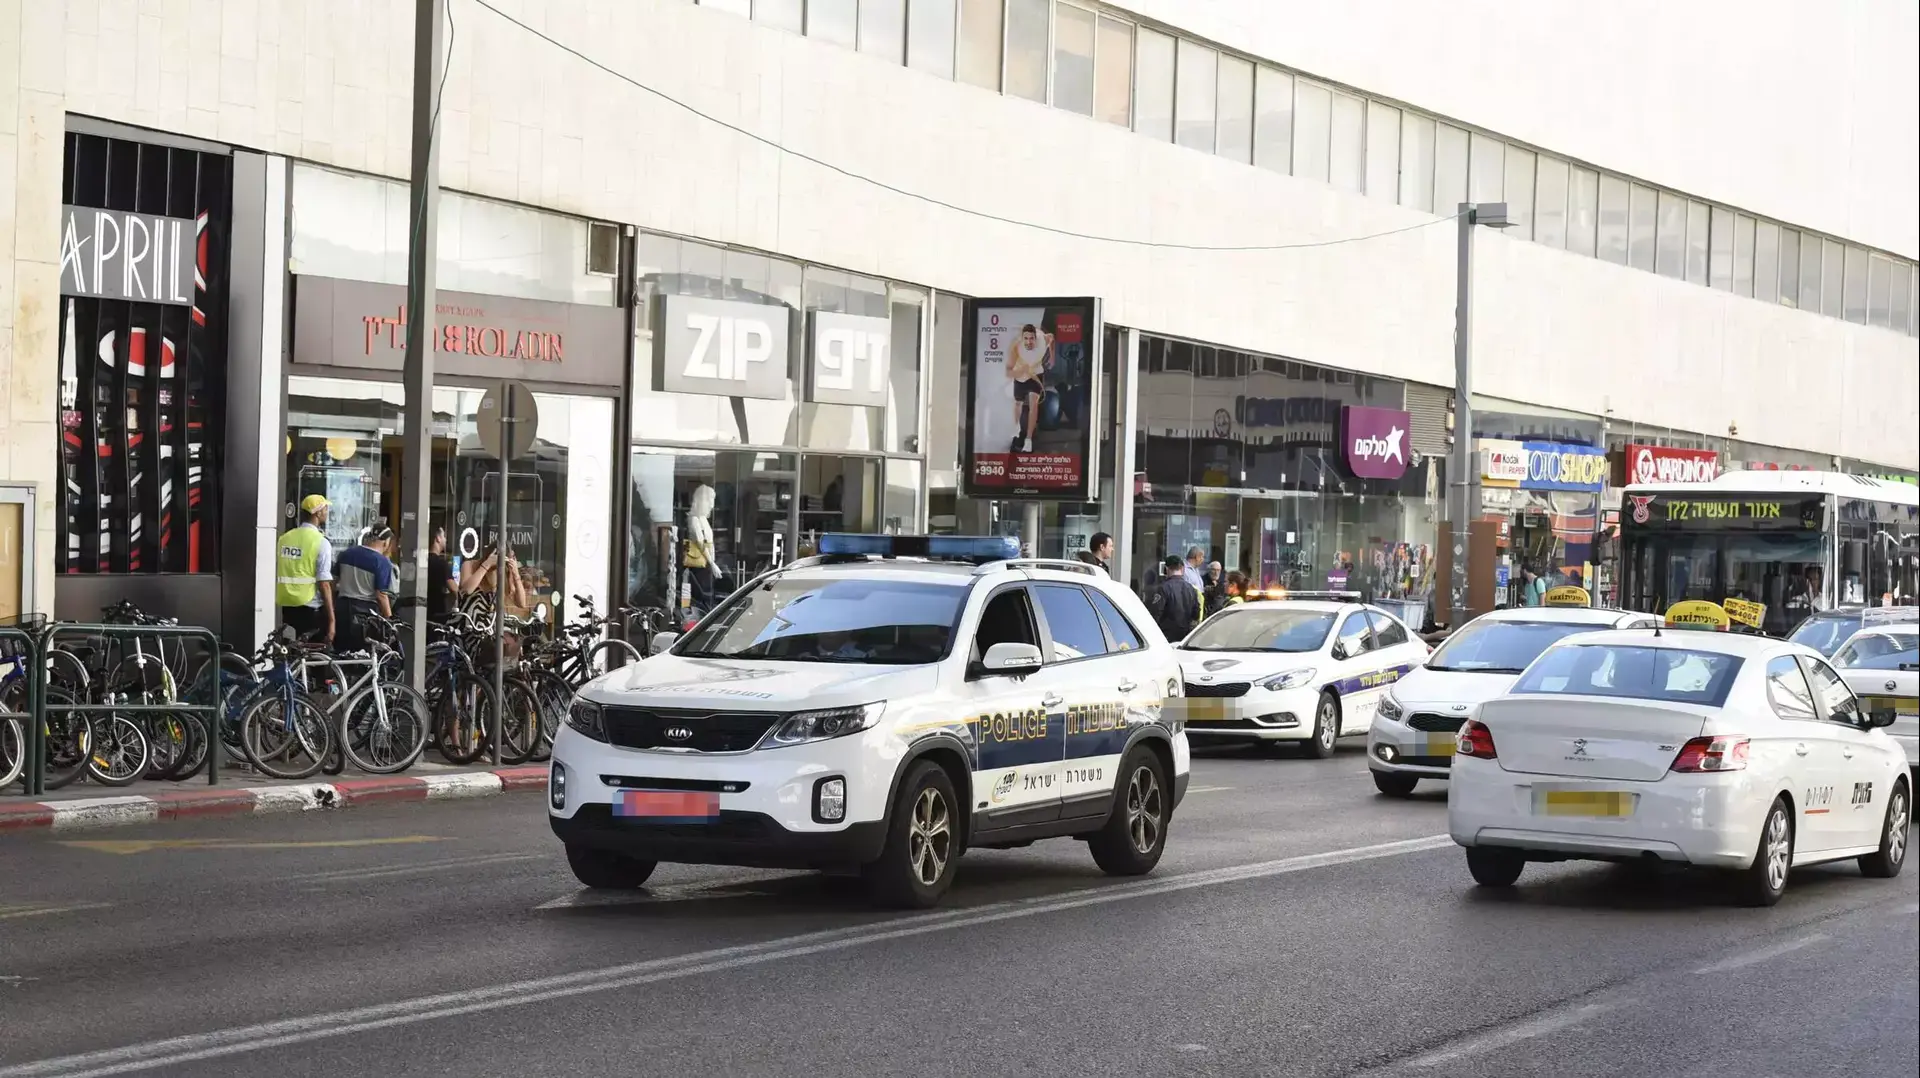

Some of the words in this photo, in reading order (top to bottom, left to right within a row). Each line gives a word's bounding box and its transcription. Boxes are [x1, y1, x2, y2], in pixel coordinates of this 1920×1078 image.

[60, 211, 187, 302] APRIL
[991, 314, 999, 326] 0
[465, 325, 564, 364] ROLADIN
[682, 313, 772, 381] ZIP
[990, 338, 998, 350] 8
[1355, 437, 1388, 460] סלקום
[1503, 454, 1519, 464] Kodak
[1528, 450, 1607, 484] OTOSHOP
[1656, 456, 1718, 482] VARDINON
[1692, 502, 1739, 518] תעשיה
[1745, 502, 1780, 518] אזור
[489, 531, 533, 545] RADIN
[1672, 612, 1693, 622] taxi
[1693, 614, 1720, 624] מונית
[979, 709, 1046, 743] POLICE
[1066, 702, 1127, 734] משטרה
[667, 728, 687, 738] KIA
[1003, 773, 1015, 784] 100
[1024, 774, 1056, 790] ישראל
[1067, 767, 1102, 783] משטרת
